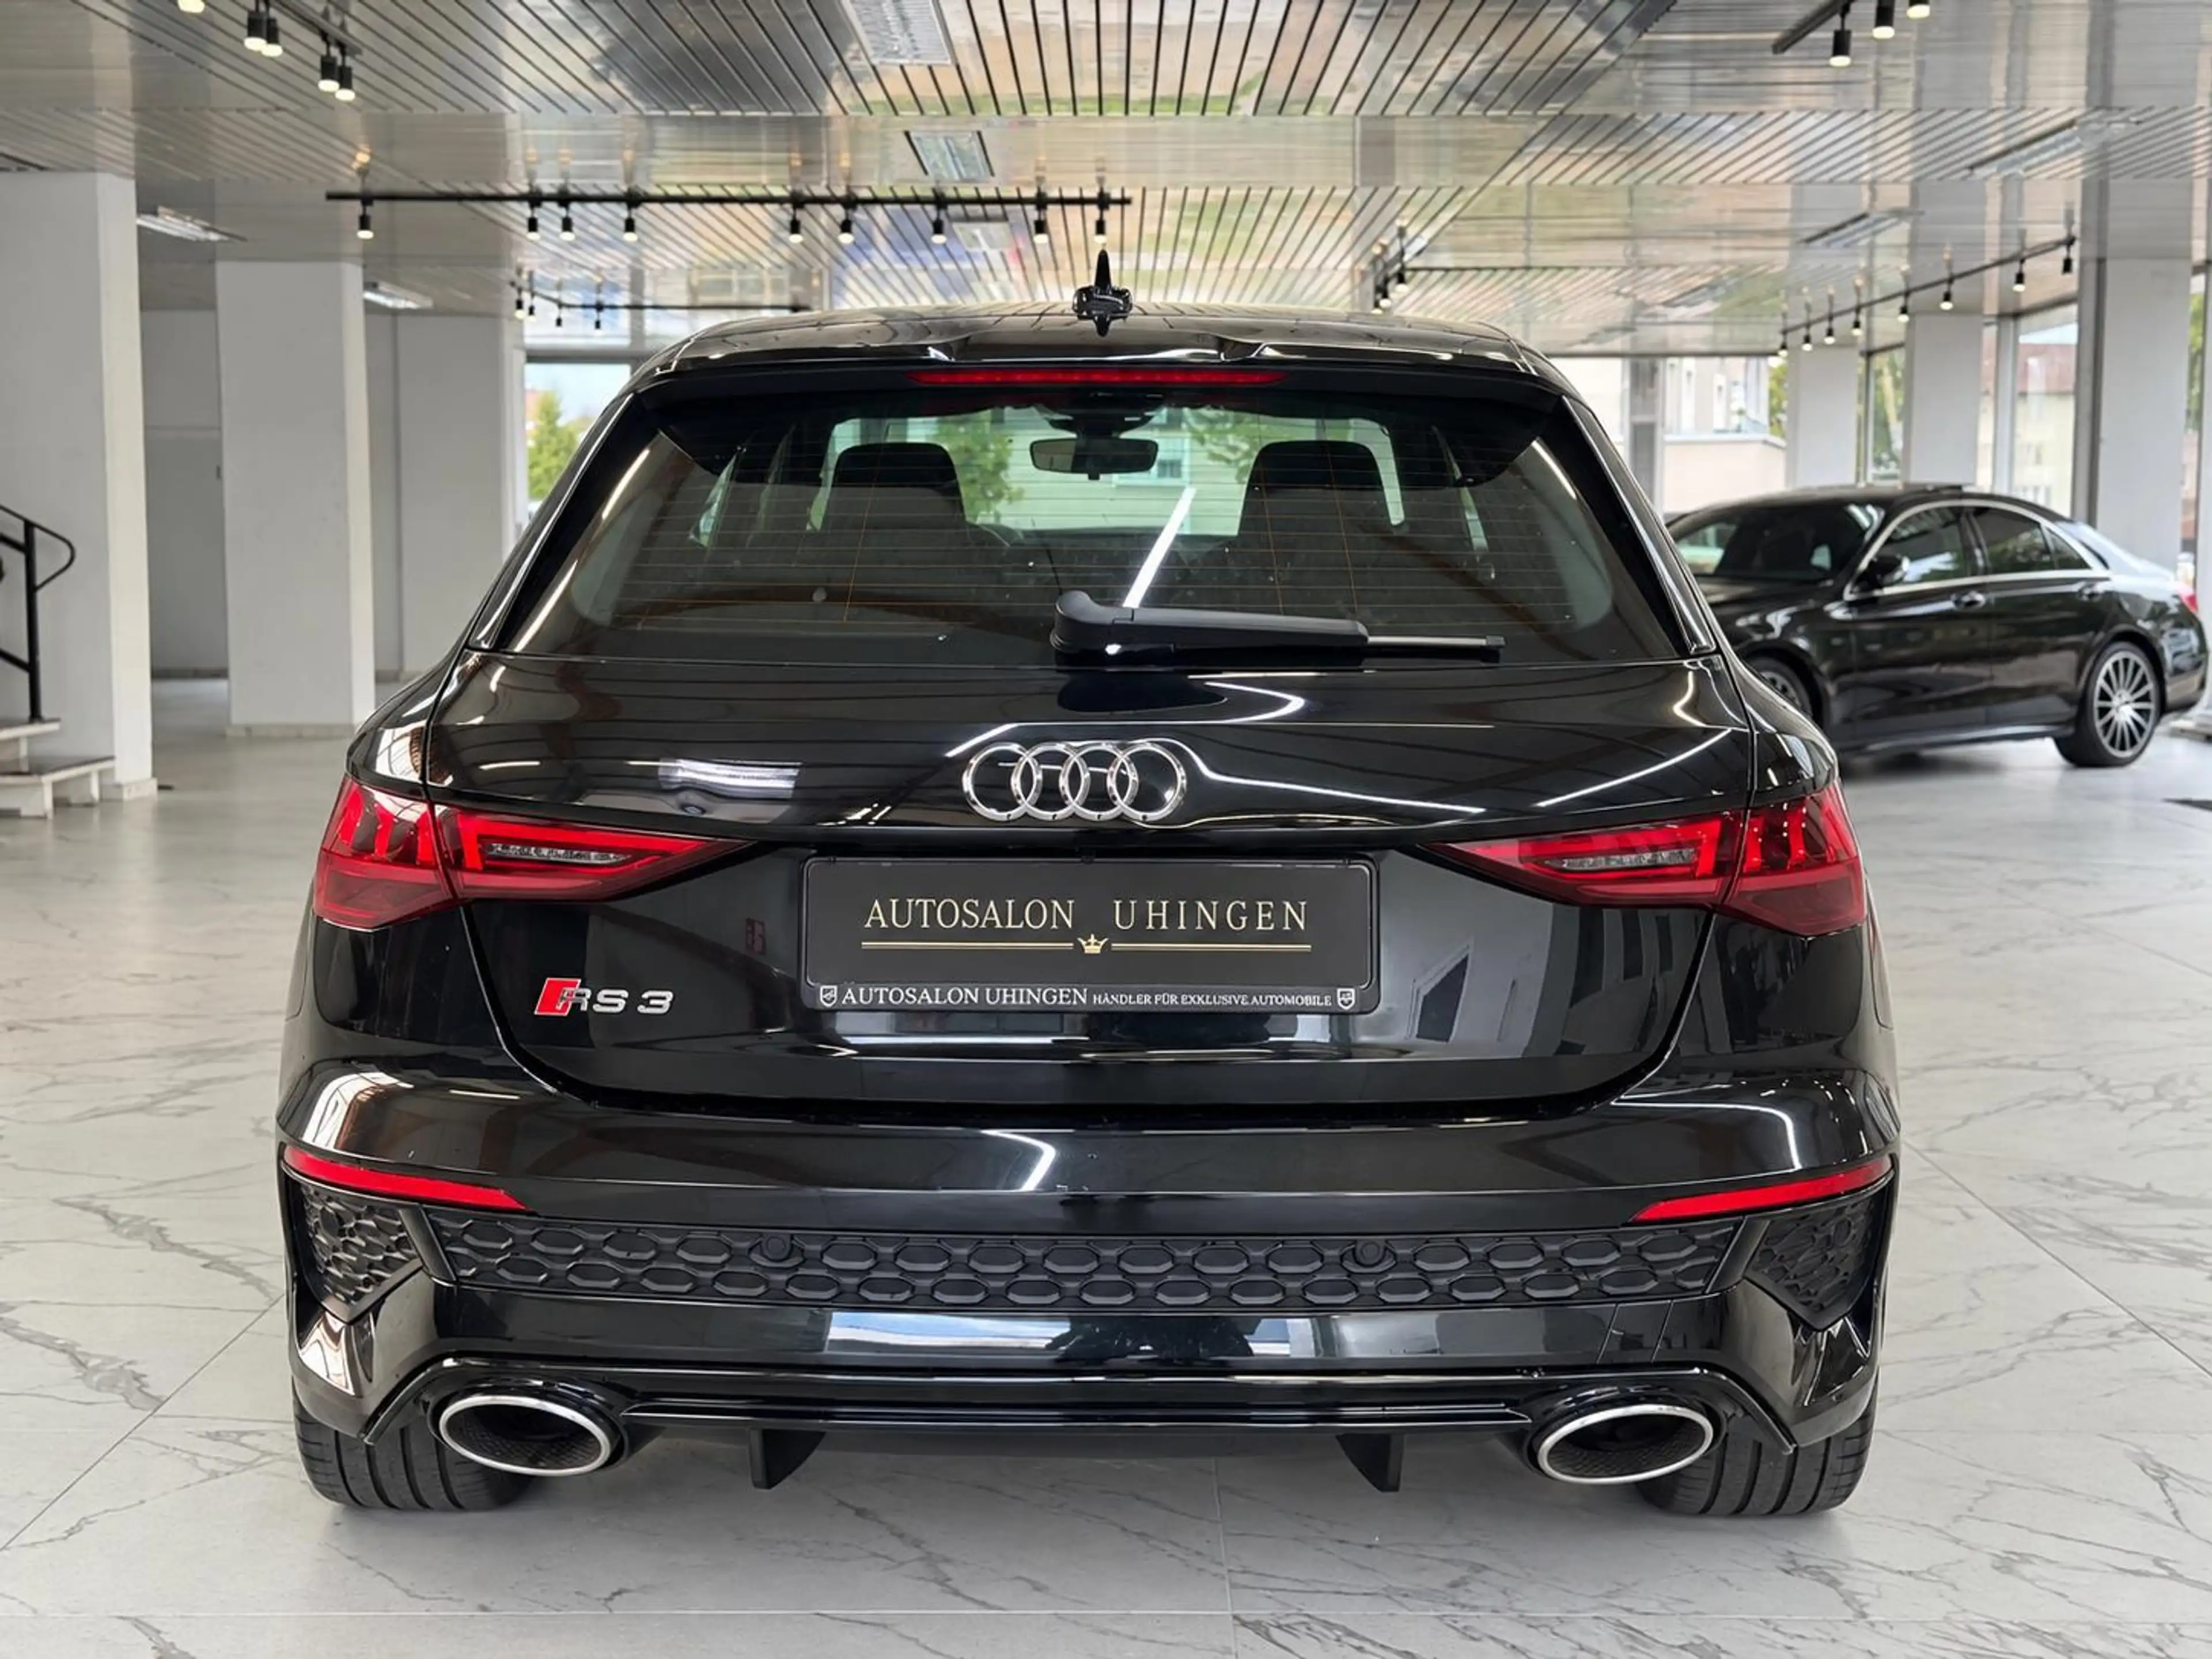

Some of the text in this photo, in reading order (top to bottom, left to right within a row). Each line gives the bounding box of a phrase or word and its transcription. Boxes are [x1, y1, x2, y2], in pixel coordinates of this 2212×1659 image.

[864, 898, 1307, 931] AUTOSALON UHINGEN
[554, 986, 674, 1014] RS 3
[842, 987, 979, 1005] AUTOSALON
[984, 987, 1087, 1006] UHINGEN
[1154, 991, 1179, 1005] FÜR
[1181, 993, 1249, 1005] EXKLUSIVE
[1252, 993, 1332, 1007] AUTOMOBILE
